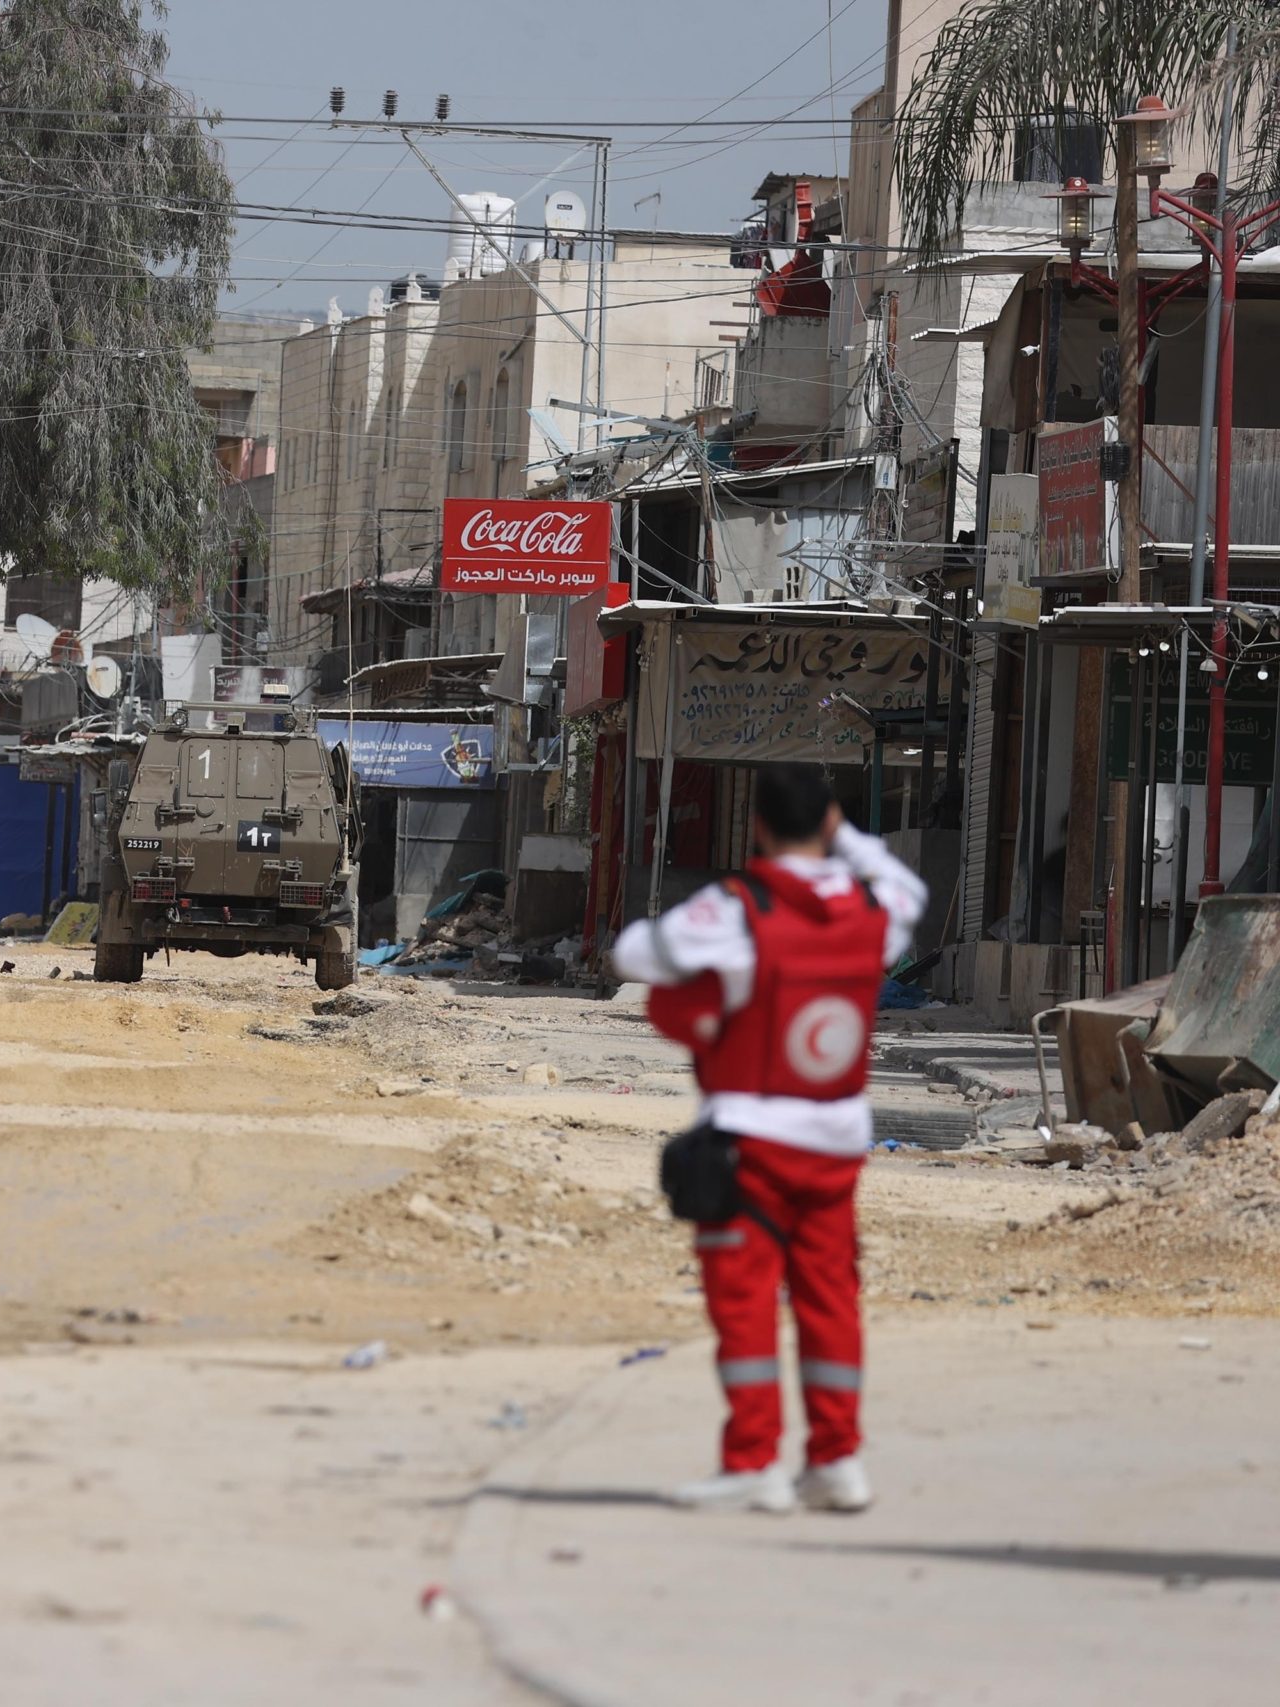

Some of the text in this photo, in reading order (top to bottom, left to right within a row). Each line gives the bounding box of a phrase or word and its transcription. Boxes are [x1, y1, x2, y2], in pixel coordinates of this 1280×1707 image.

[460, 509, 591, 555] Coca-Cola
[455, 567, 596, 586] سوبر ماركت العجوز
[1125, 668, 1209, 688] TLKAEM
[198, 749, 211, 779] 1
[127, 840, 159, 849] 252219
